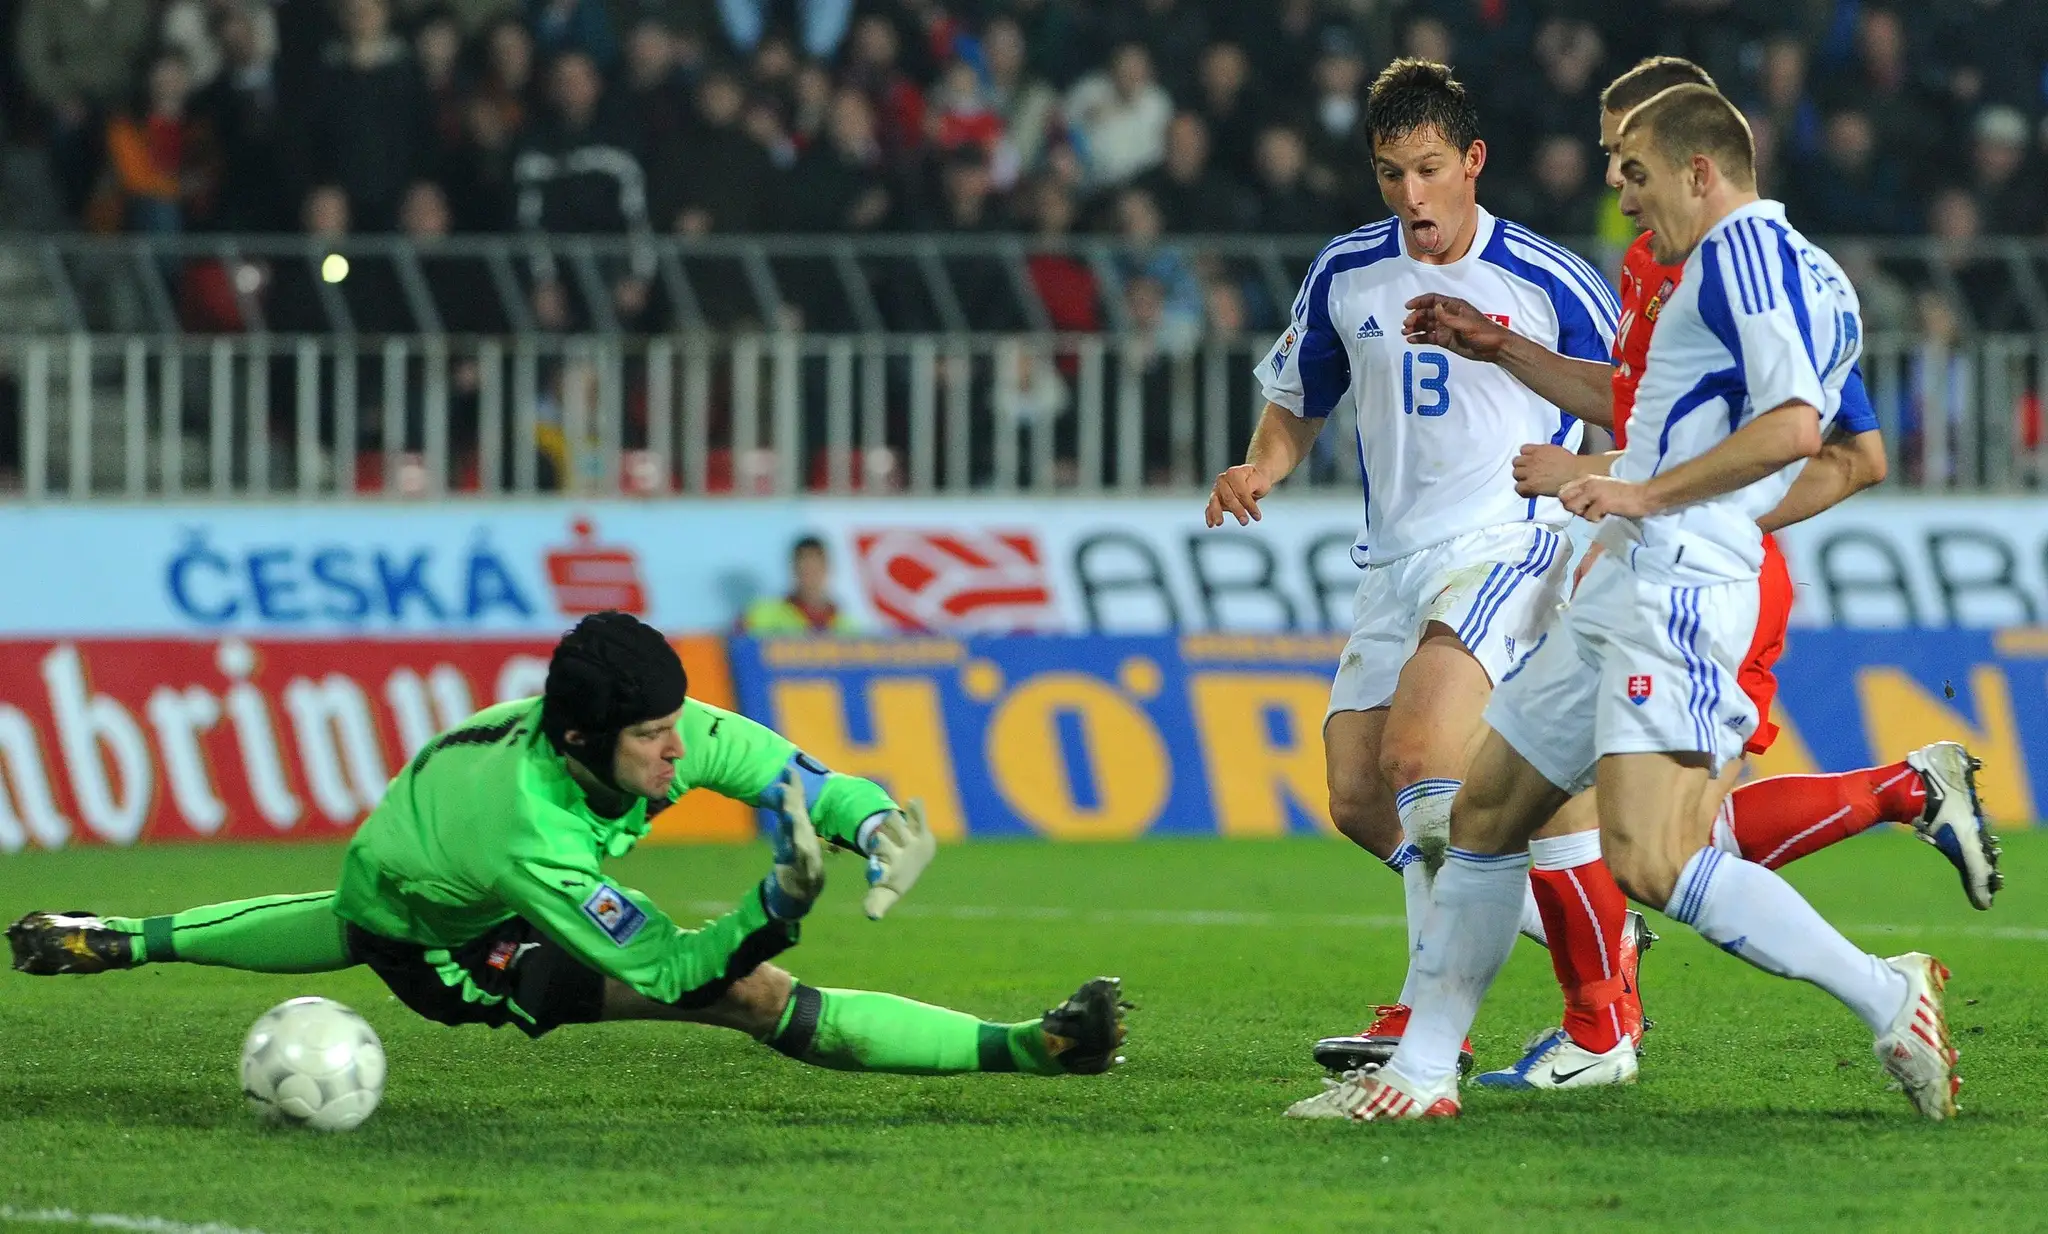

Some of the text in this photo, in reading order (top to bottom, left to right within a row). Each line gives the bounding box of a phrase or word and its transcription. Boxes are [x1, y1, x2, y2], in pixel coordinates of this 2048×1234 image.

[1356, 329, 1384, 340] adidas
[1402, 351, 1450, 416] 13
[167, 527, 536, 624] ČESKÁ
[0, 640, 549, 850] brinu
